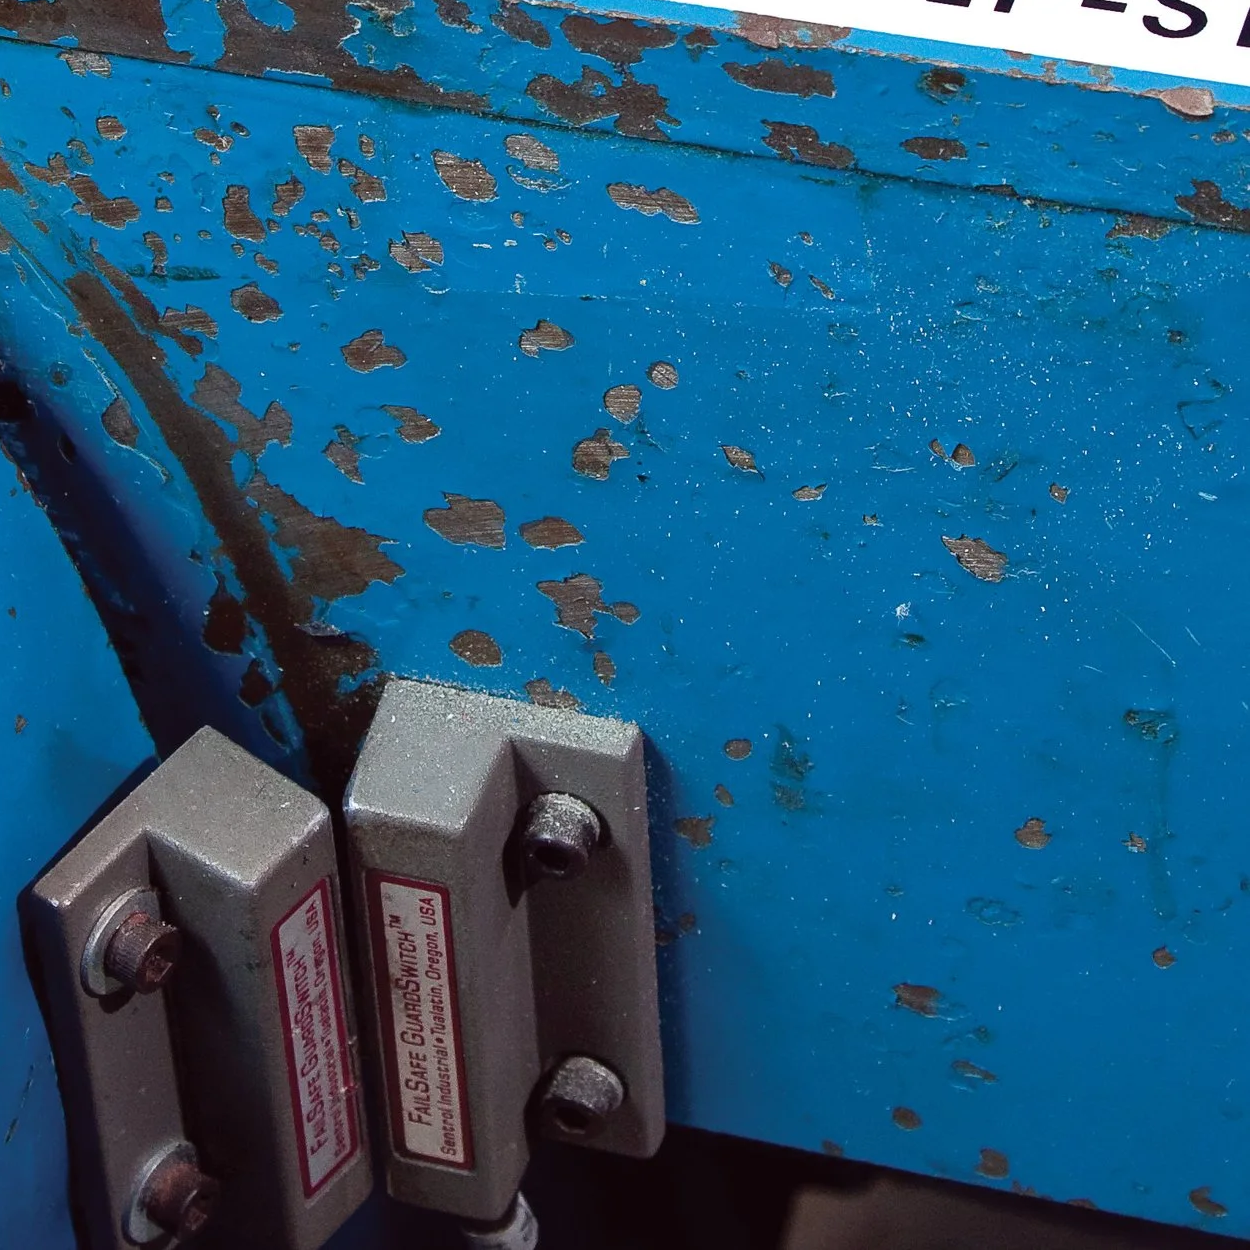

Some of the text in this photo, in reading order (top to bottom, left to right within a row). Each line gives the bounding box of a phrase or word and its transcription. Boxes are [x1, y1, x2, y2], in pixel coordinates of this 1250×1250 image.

[305, 901, 319, 935] USA
[418, 897, 437, 927] USA
[432, 1044, 452, 1101] Industrial
